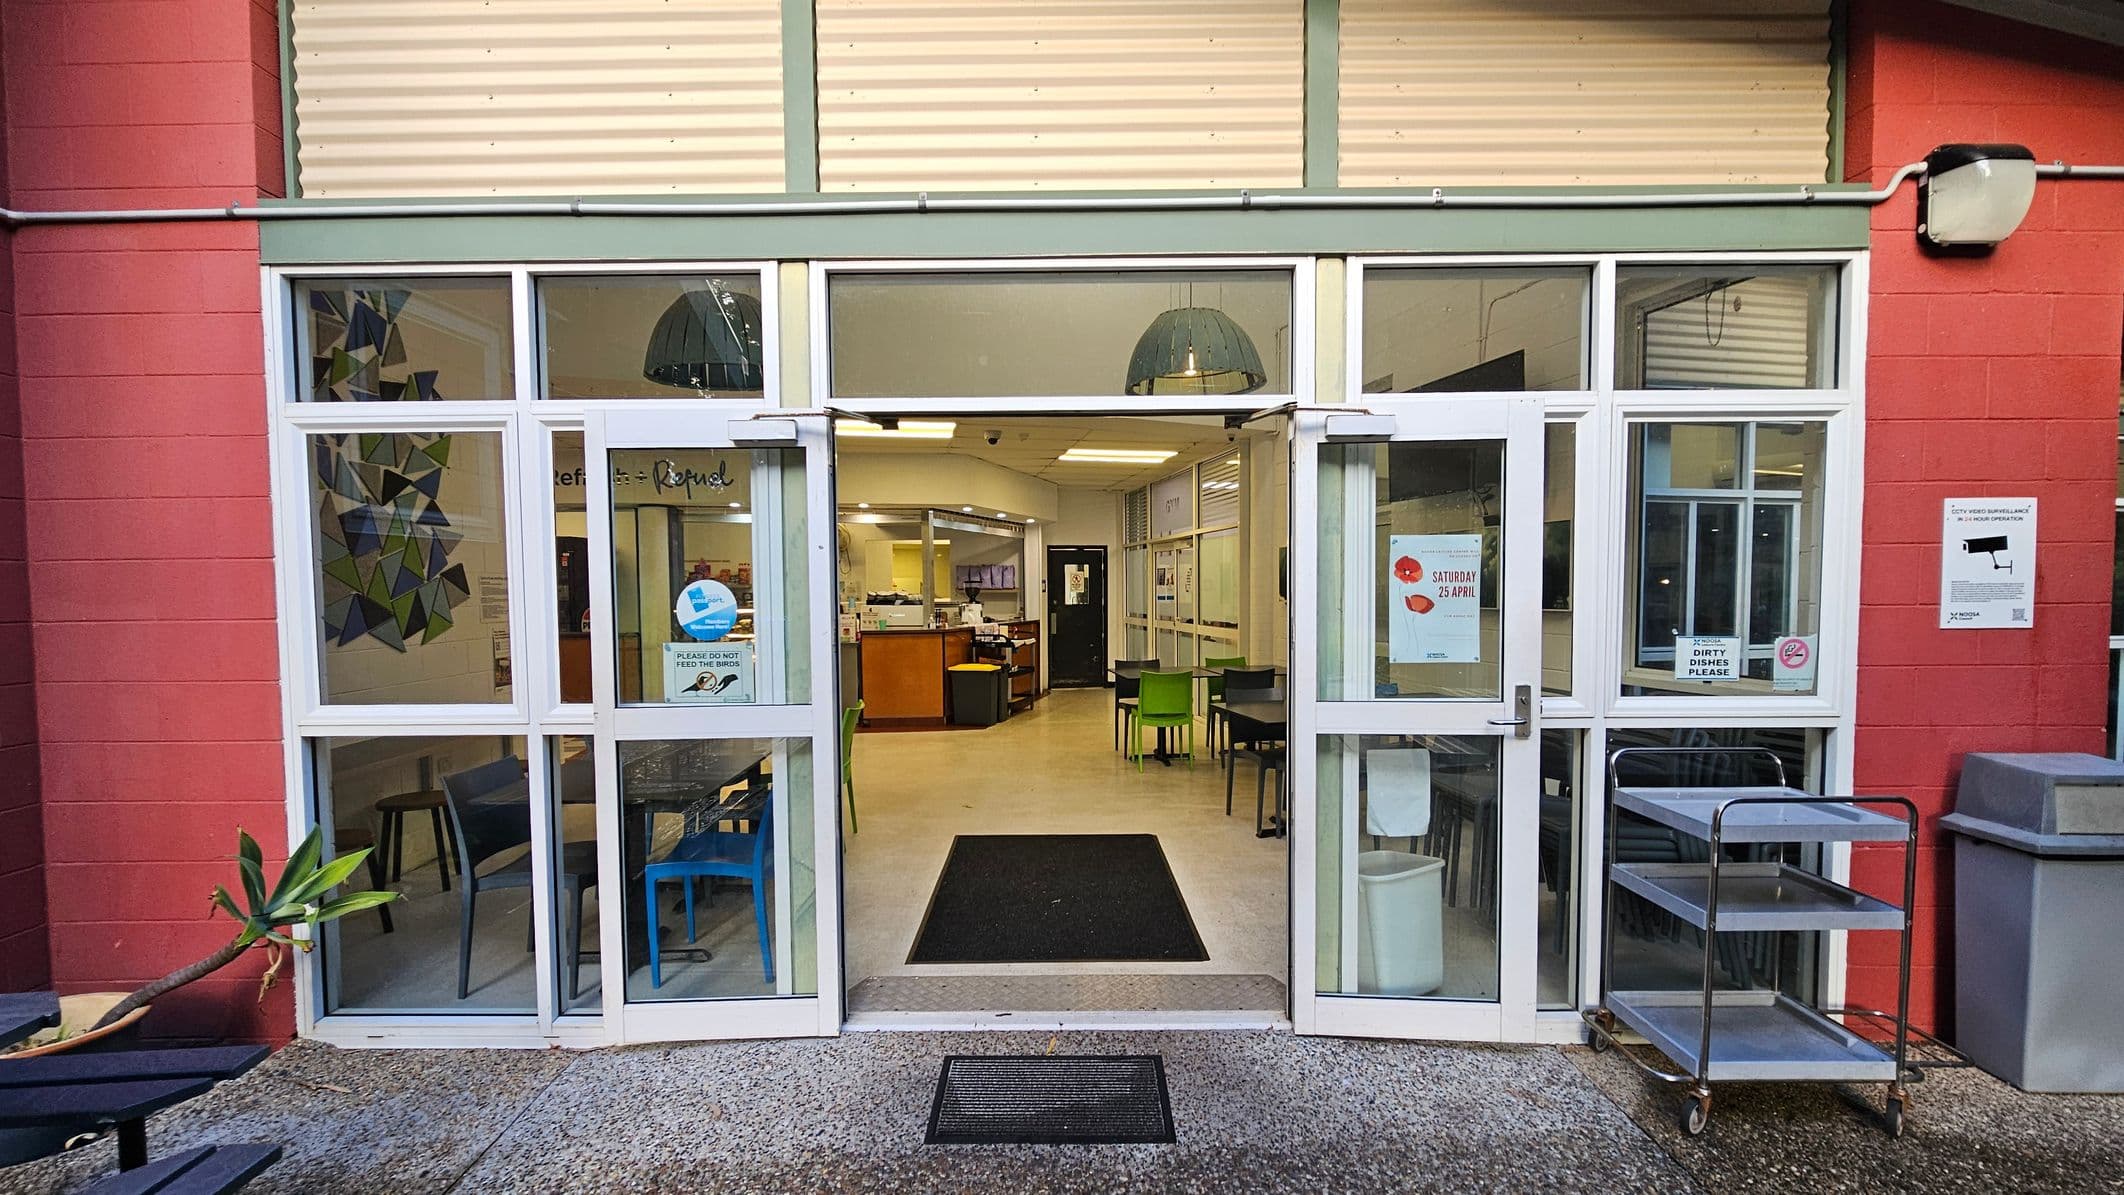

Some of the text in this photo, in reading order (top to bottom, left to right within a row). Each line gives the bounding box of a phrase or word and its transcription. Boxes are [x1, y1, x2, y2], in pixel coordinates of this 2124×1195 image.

[653, 459, 734, 500] Refuel
[1432, 571, 1477, 583] SATURDAY
[1438, 586, 1476, 598] 25 APRIL
[1693, 649, 1726, 657] DIRTY
[1690, 659, 1729, 667] DISHES
[1688, 668, 1730, 676] PLEASE
